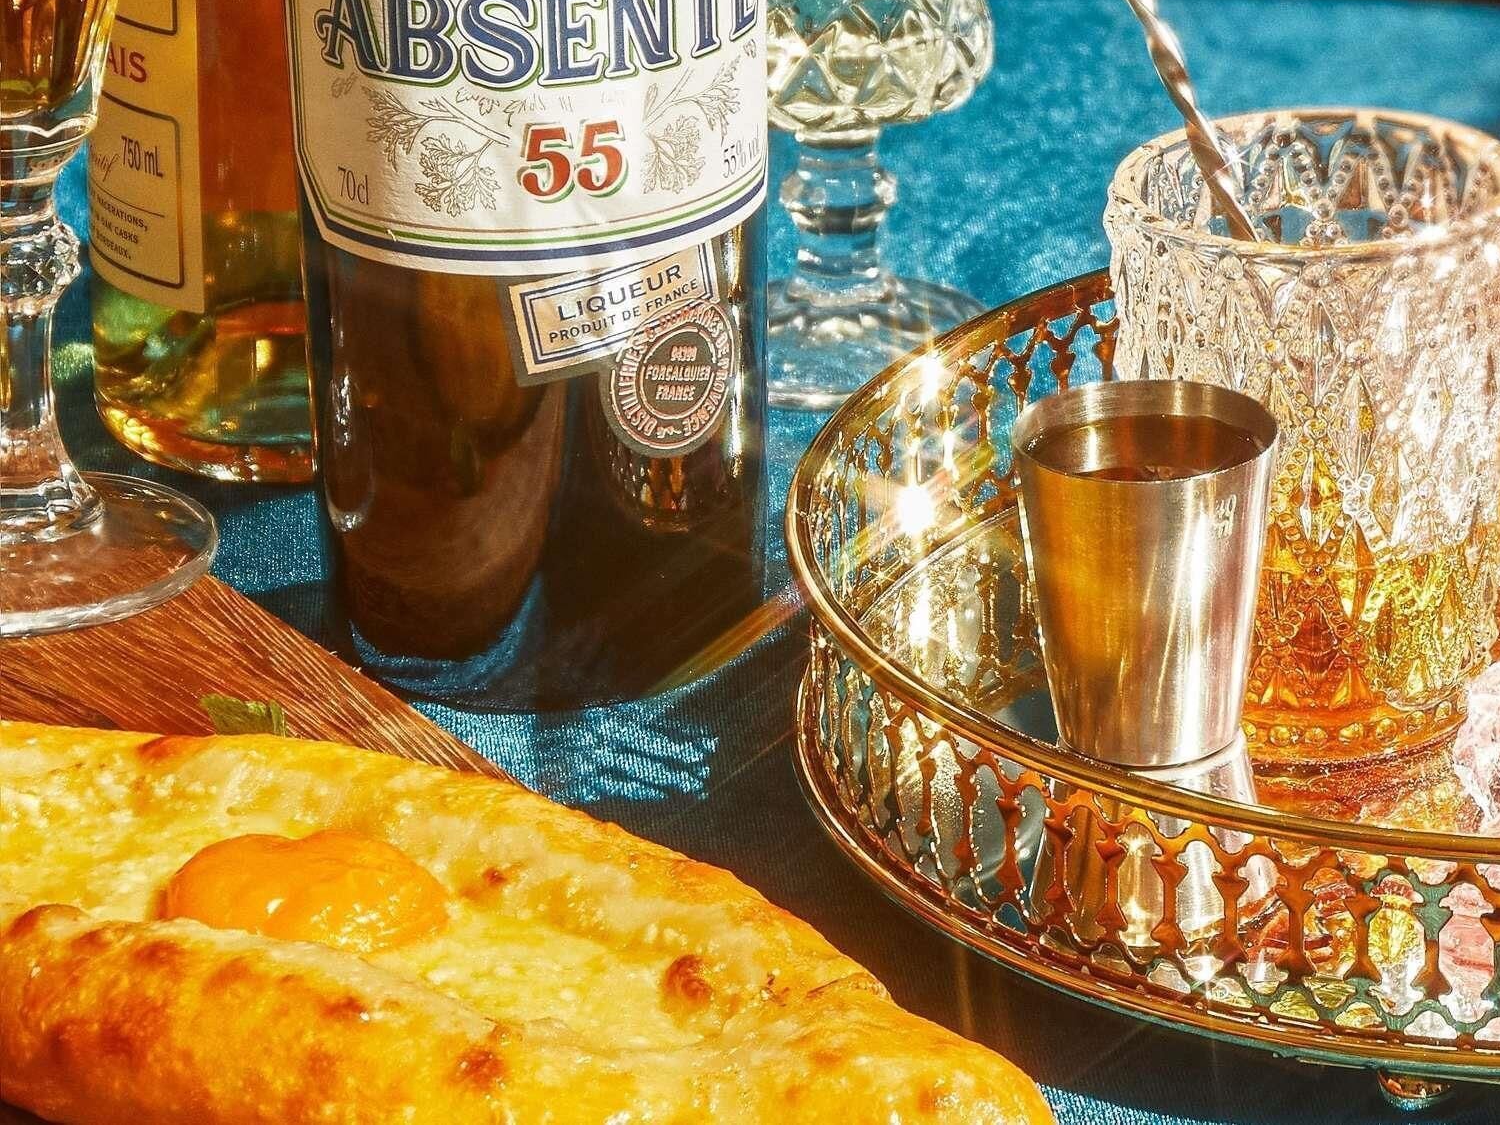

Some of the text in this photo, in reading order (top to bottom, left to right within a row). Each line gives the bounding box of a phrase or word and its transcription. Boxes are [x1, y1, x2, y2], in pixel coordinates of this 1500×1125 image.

[121, 135, 141, 172] 750
[518, 119, 628, 202] 55
[337, 165, 369, 206] 70cl
[549, 277, 699, 344] PRODUIT DE FRANCE
[557, 264, 682, 321] LIQUEUR
[618, 336, 658, 437] DISTILLERIES
[682, 358, 730, 436] PROVENCE
[645, 364, 711, 381] FORCALQUIER
[655, 384, 697, 401] FRANCE
